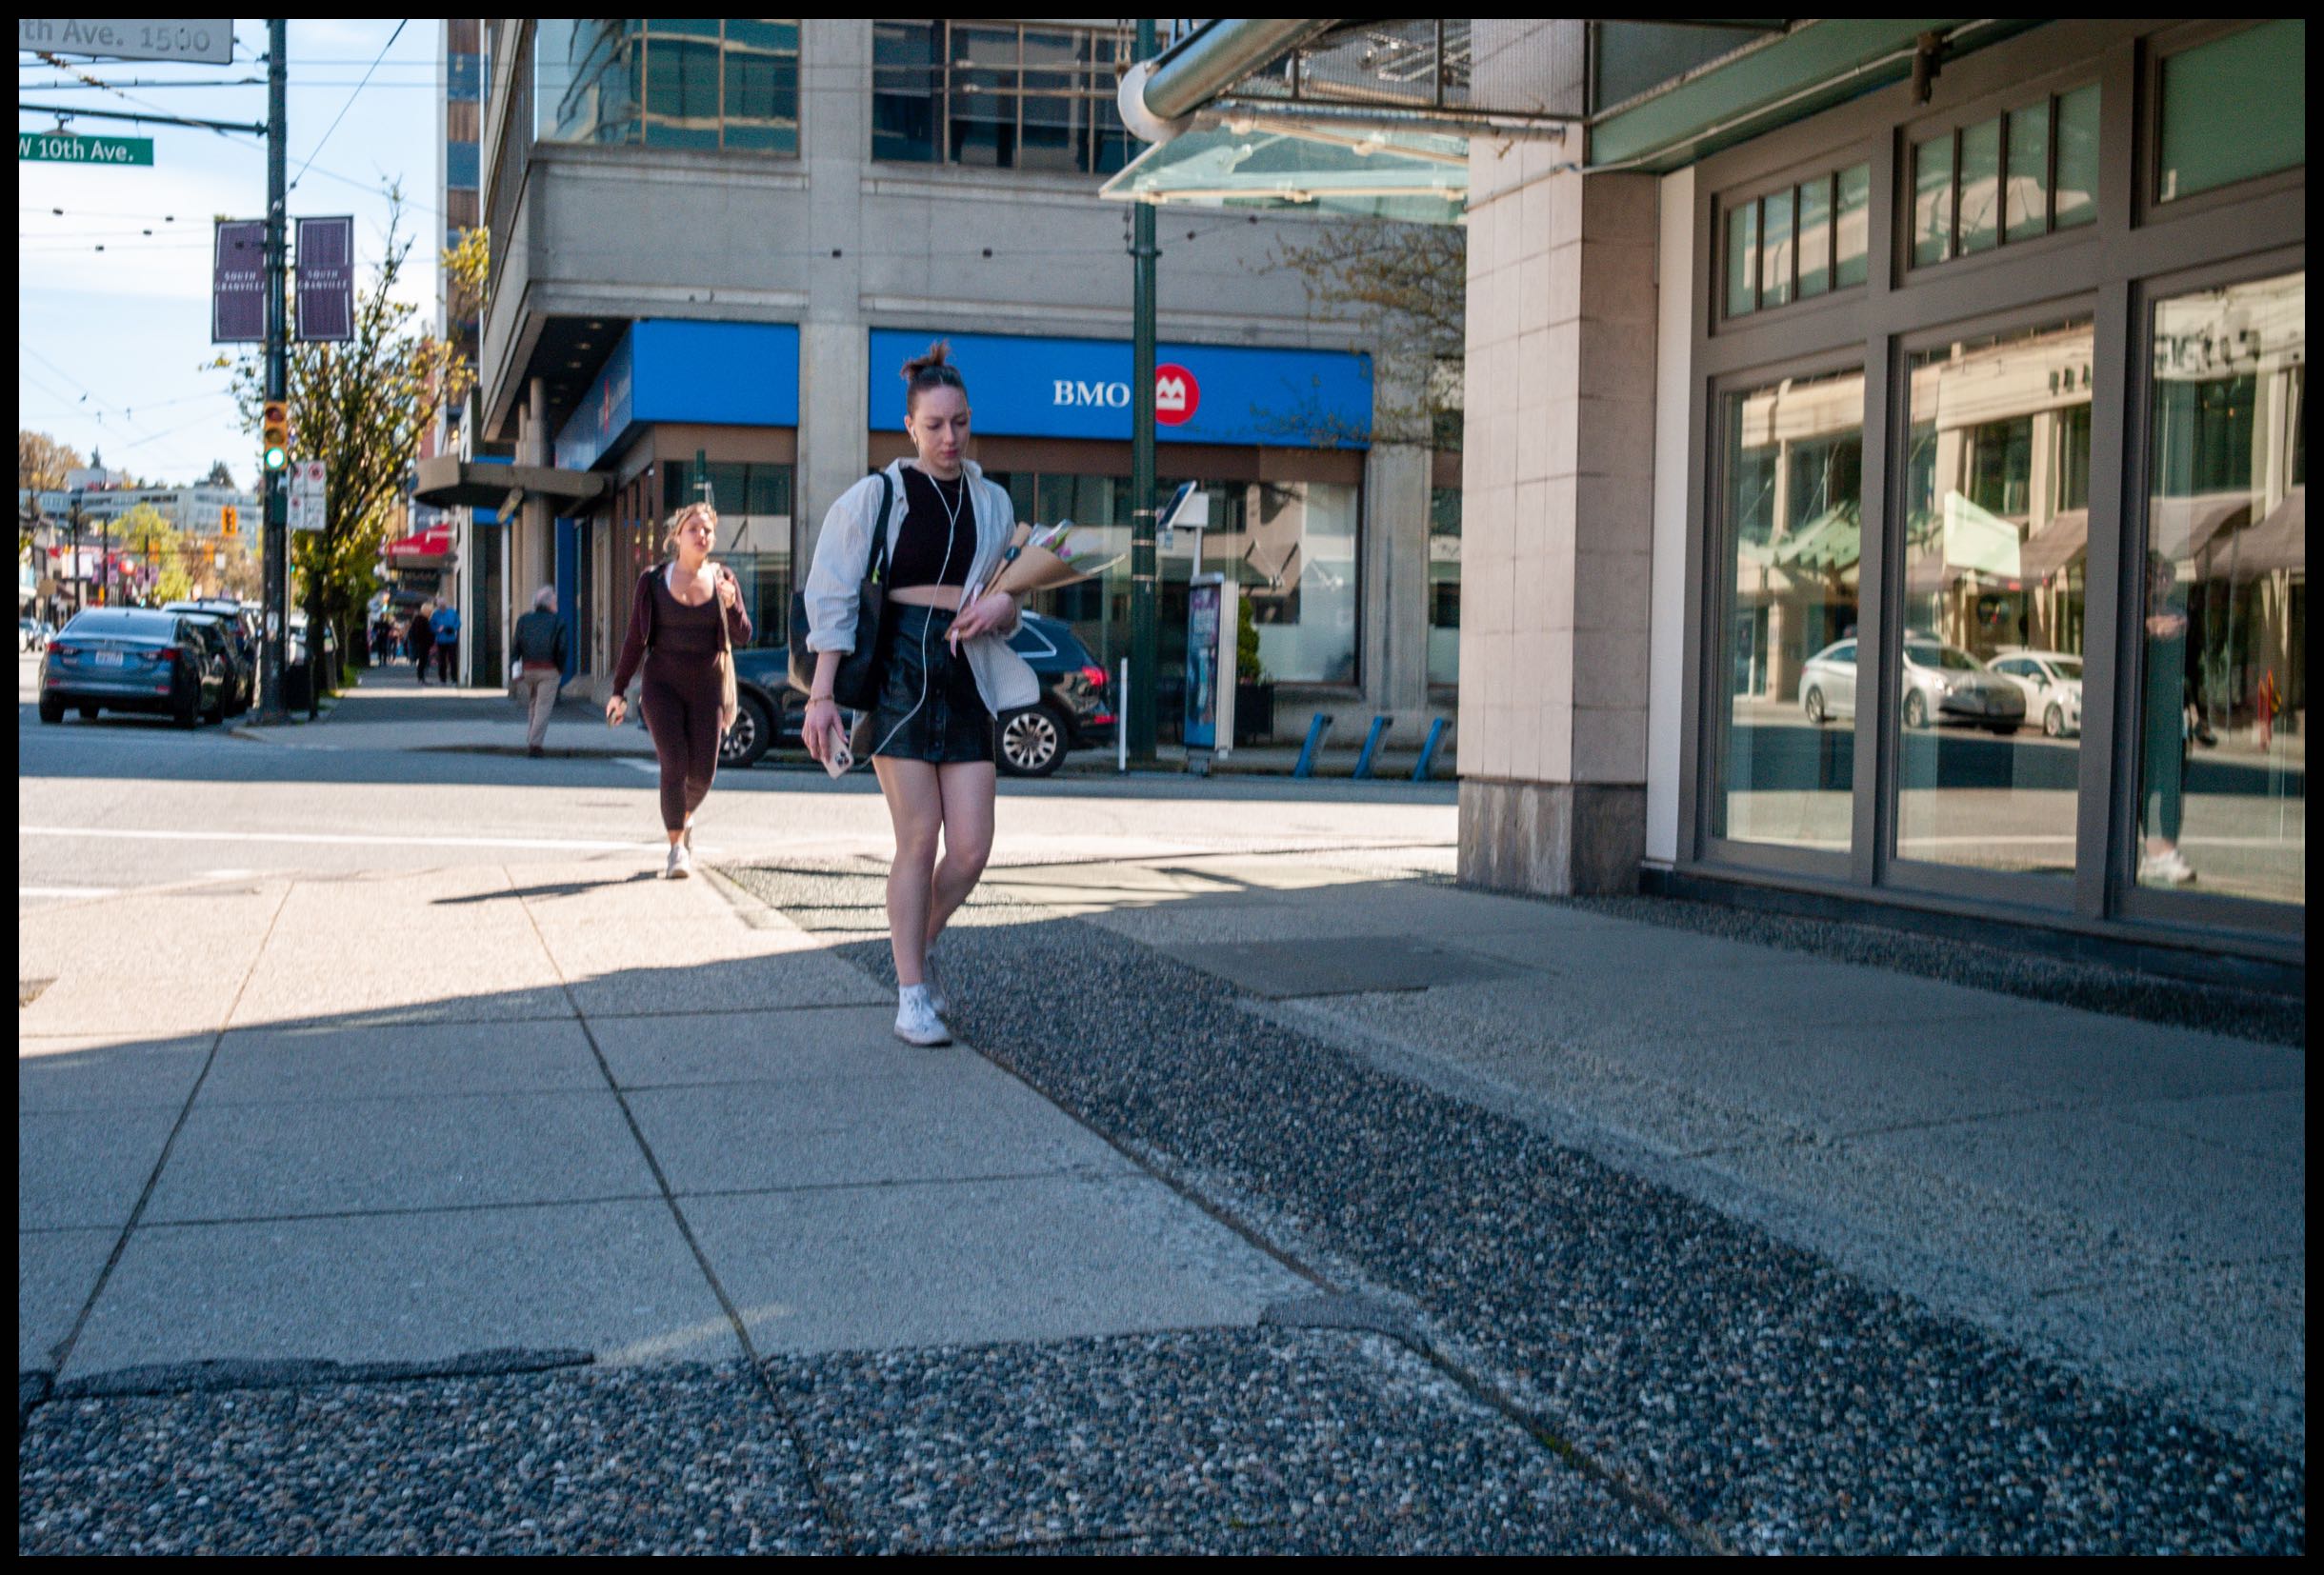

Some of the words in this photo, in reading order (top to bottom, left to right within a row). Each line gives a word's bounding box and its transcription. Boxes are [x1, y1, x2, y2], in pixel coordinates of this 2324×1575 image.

[63, 19, 124, 47] Ave.
[140, 27, 210, 52] 1500
[38, 137, 85, 161] 10th
[90, 139, 134, 162] Ave.
[1052, 379, 1132, 409] BMO
